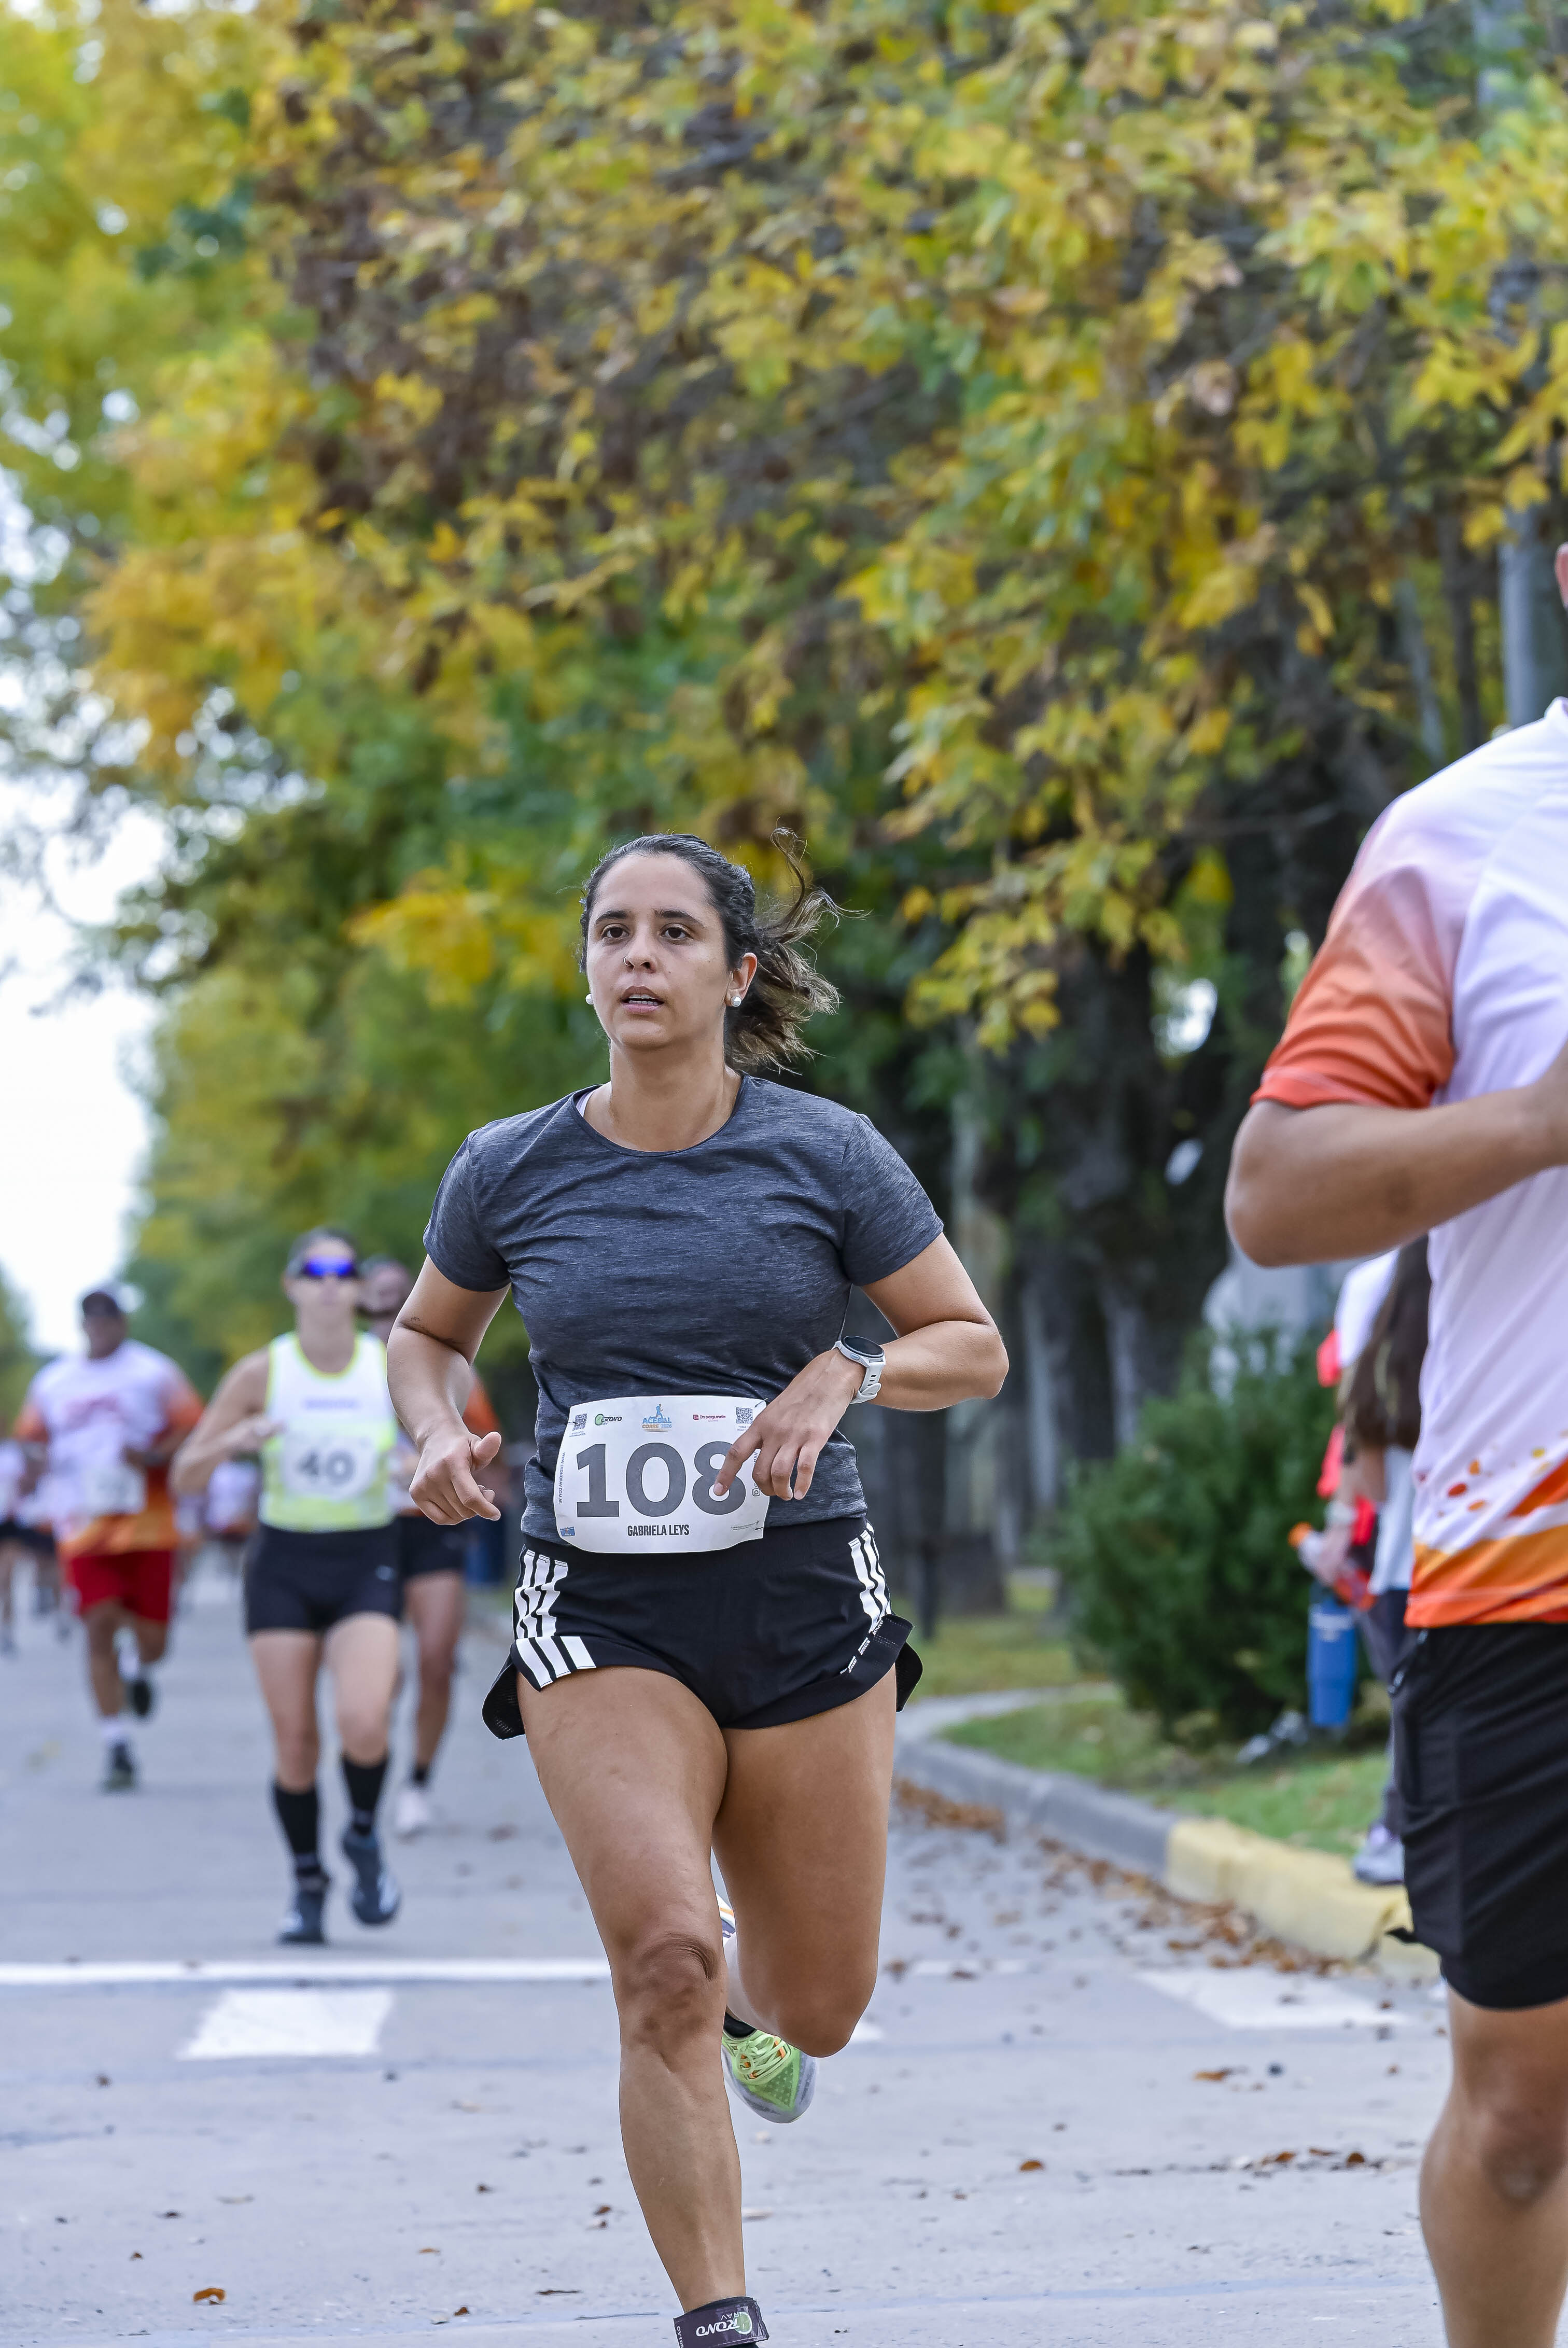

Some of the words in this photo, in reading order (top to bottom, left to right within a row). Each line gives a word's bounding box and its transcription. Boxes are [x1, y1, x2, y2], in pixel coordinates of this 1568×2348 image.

[295, 1448, 357, 1487] 40
[576, 1441, 746, 1518] 108
[627, 1525, 667, 1536] GABRIELA
[669, 1524, 690, 1535] LEYS
